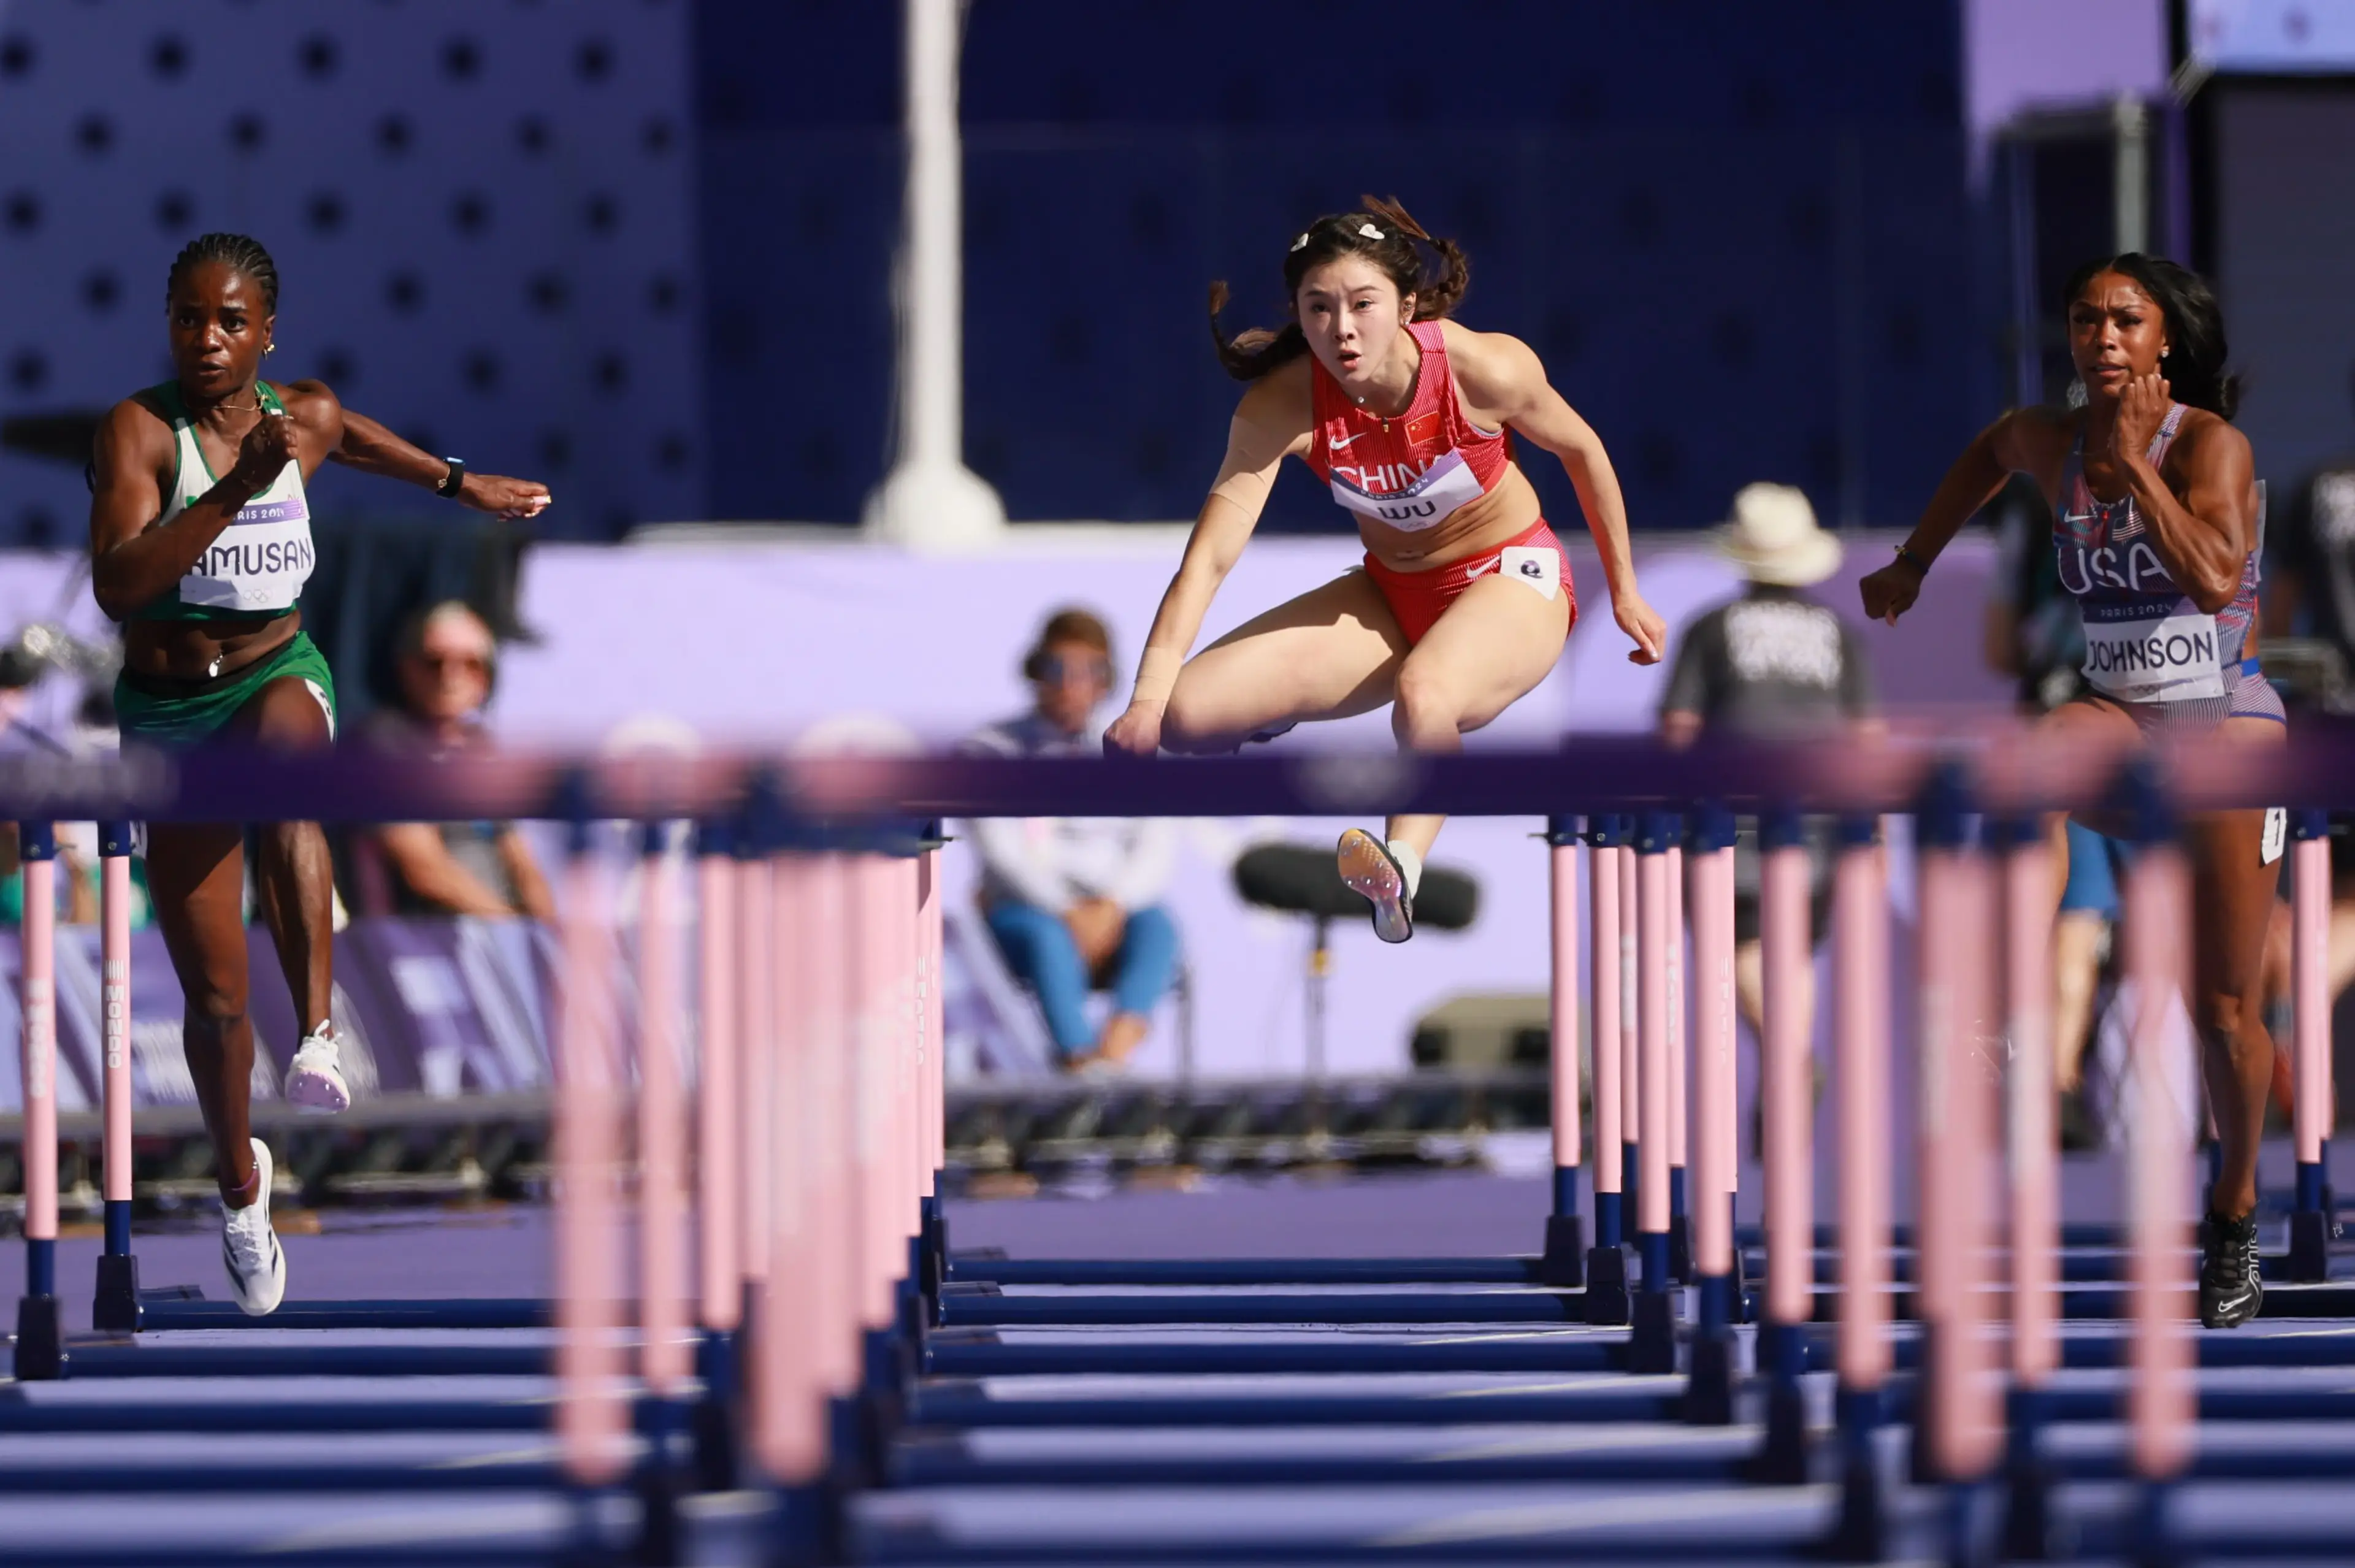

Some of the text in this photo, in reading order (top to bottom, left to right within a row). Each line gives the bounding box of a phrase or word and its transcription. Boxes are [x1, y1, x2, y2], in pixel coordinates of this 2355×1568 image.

[1334, 455, 1443, 491] HIN
[1378, 500, 1436, 520] WU
[2058, 542, 2173, 594] USA
[2137, 602, 2172, 615] 2024
[2088, 631, 2214, 672] JOHNSON
[105, 985, 124, 1068] MONDO
